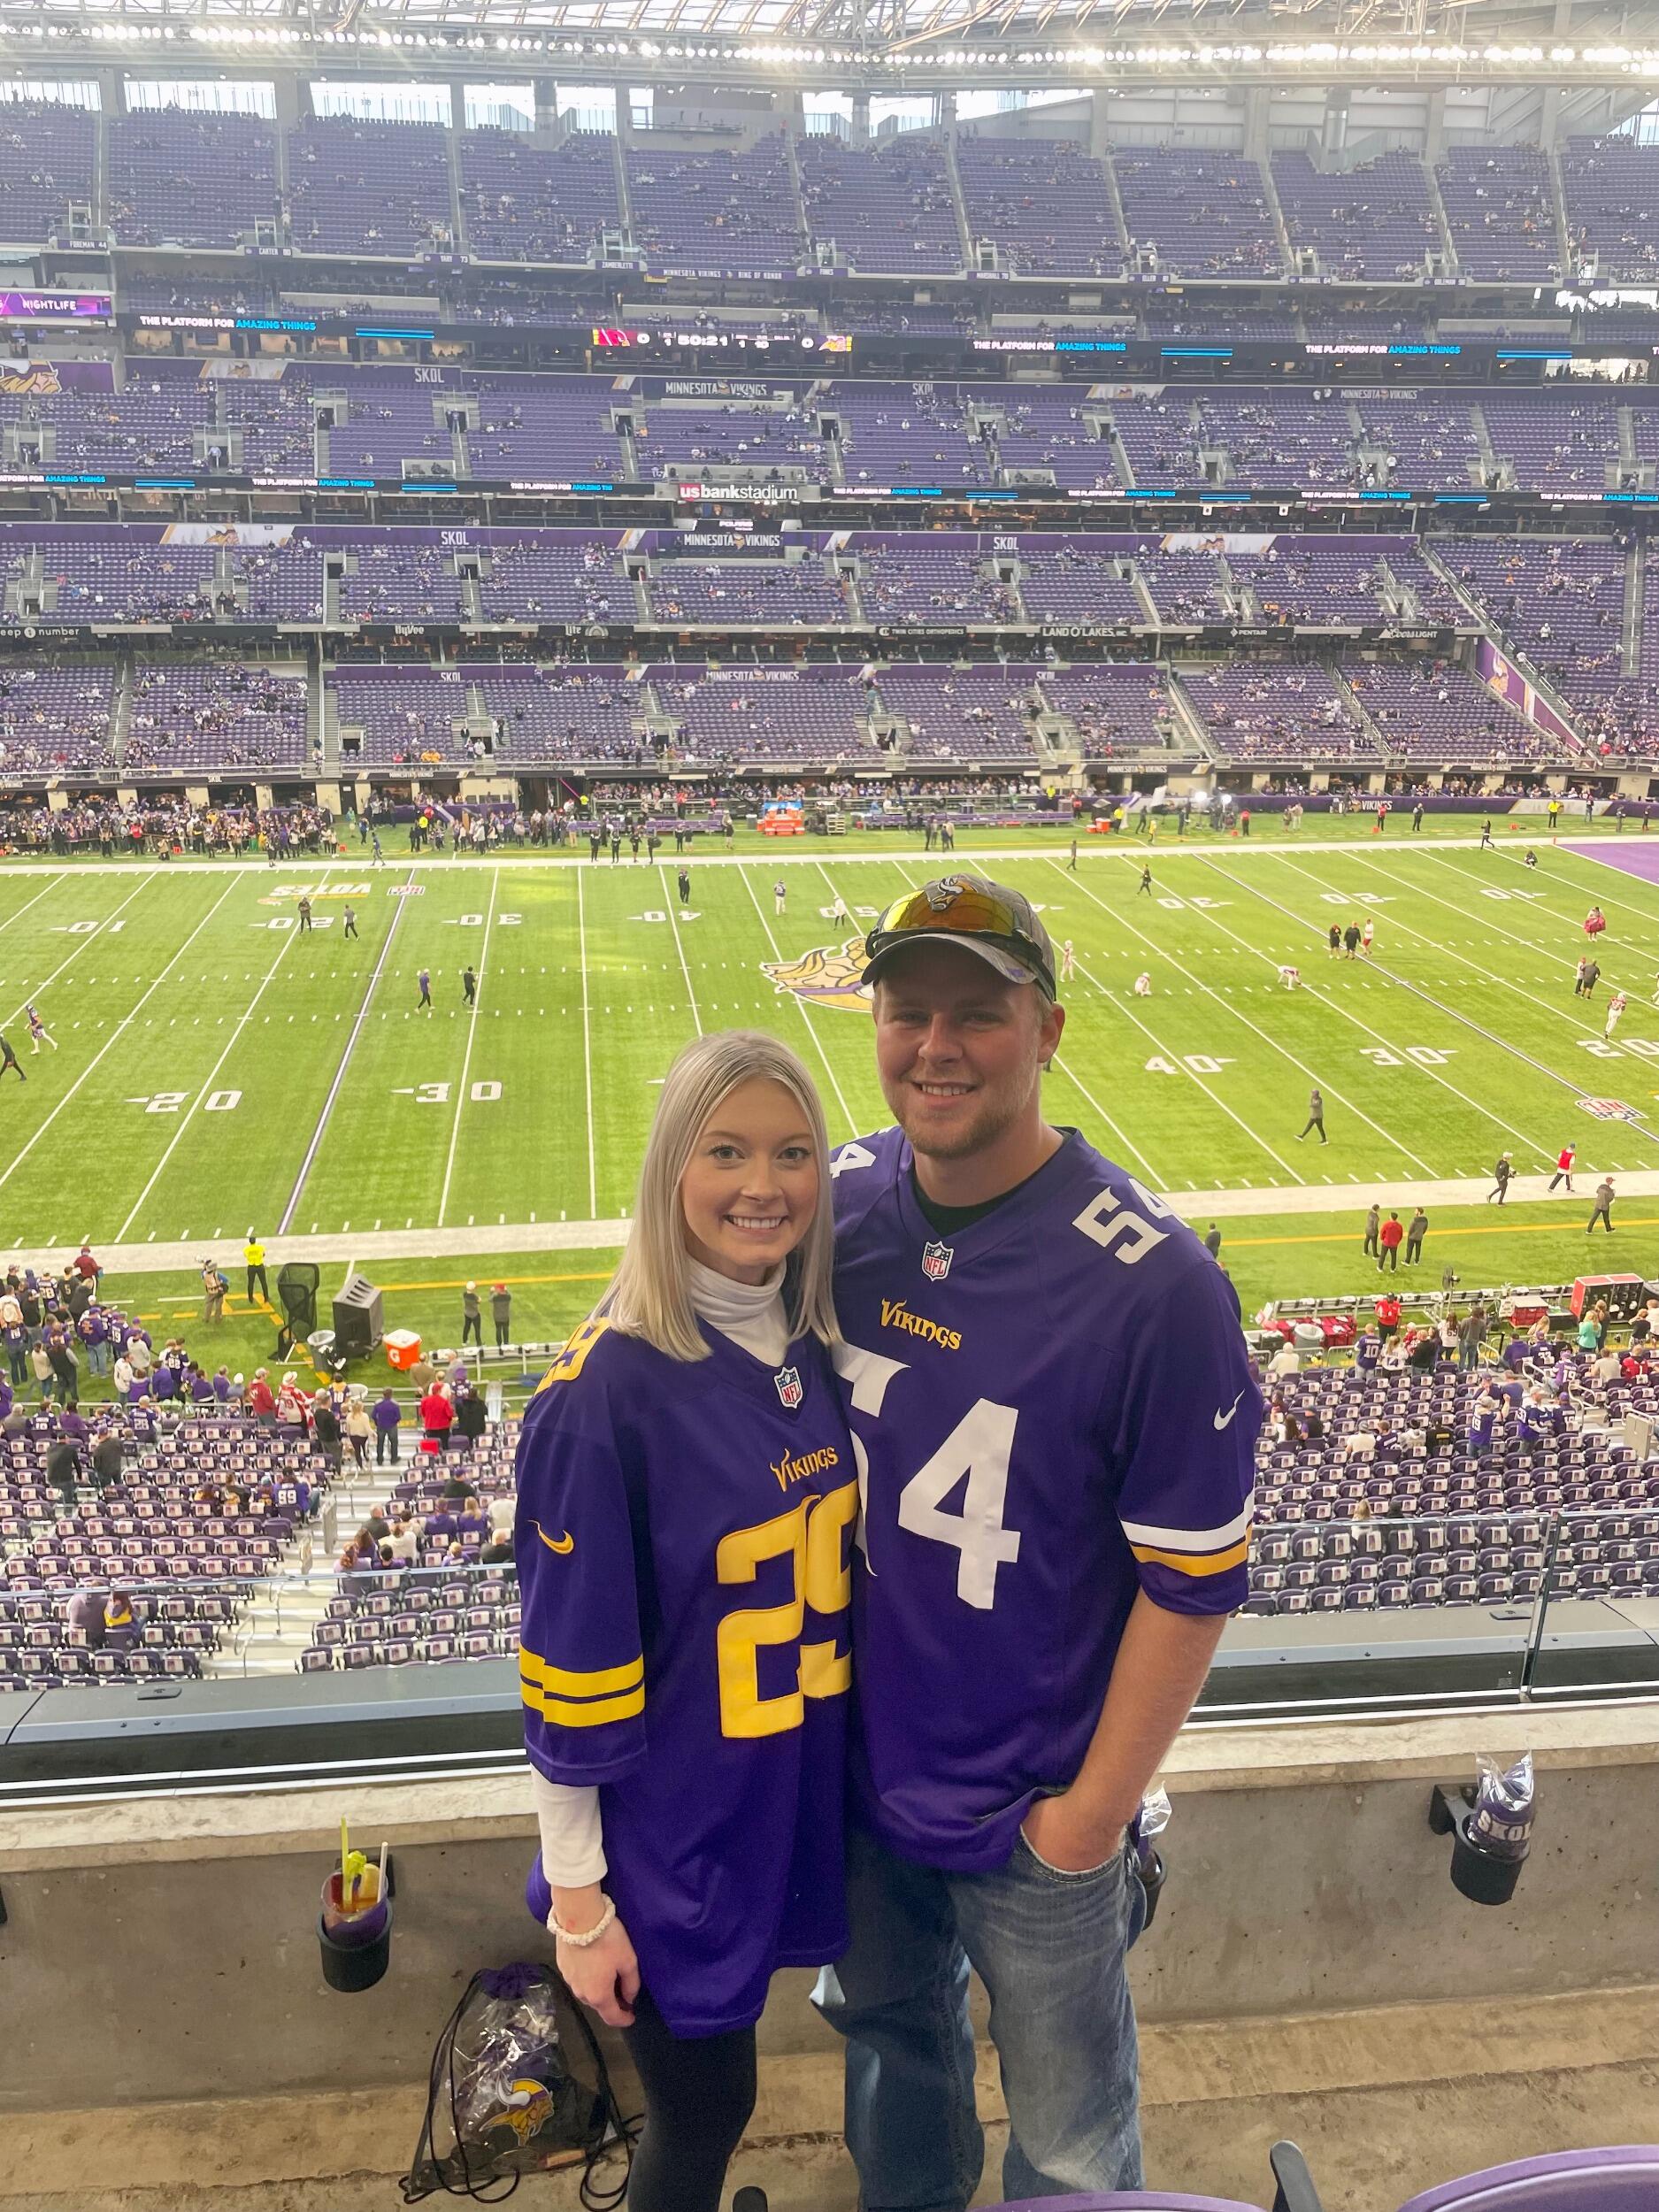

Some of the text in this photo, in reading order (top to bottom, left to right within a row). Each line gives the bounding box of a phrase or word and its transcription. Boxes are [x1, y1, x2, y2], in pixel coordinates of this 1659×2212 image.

[22, 299, 77, 311] NIGHTLIFE
[140, 315, 317, 331] THE PLATFORM FOR AMAZING THINGS
[636, 333, 650, 343] 0
[677, 334, 728, 346] 50:21
[801, 338, 814, 349] 0
[973, 341, 1126, 351] THE PLATFORM FOR AMAZING THINGS
[1305, 344, 1461, 354] THE PLATFORM FOR AMAZING THINGS
[414, 367, 445, 383] SKOL
[665, 382, 767, 396] MINNESOTA VIKINGS
[1340, 388, 1418, 399] MINNESOTA VIKINGS
[441, 531, 470, 545] SKOL
[684, 534, 780, 547] MINNESOTA VIKINGS
[994, 536, 1019, 550] SKOL
[38, 626, 80, 636] number
[395, 625, 425, 636] HyVee
[1042, 627, 1069, 637] LAND
[705, 670, 800, 680] MINNESOTA VIKINGS
[1362, 800, 1393, 810] VIKINGS
[1071, 1177, 1192, 1264] 54
[924, 1257, 948, 1277] NFL
[389, 1348, 401, 1363] G
[1363, 1345, 1379, 1359] 10
[784, 1384, 802, 1405] NFL
[1471, 1417, 1481, 1432] 19
[716, 1479, 858, 1739] 29
